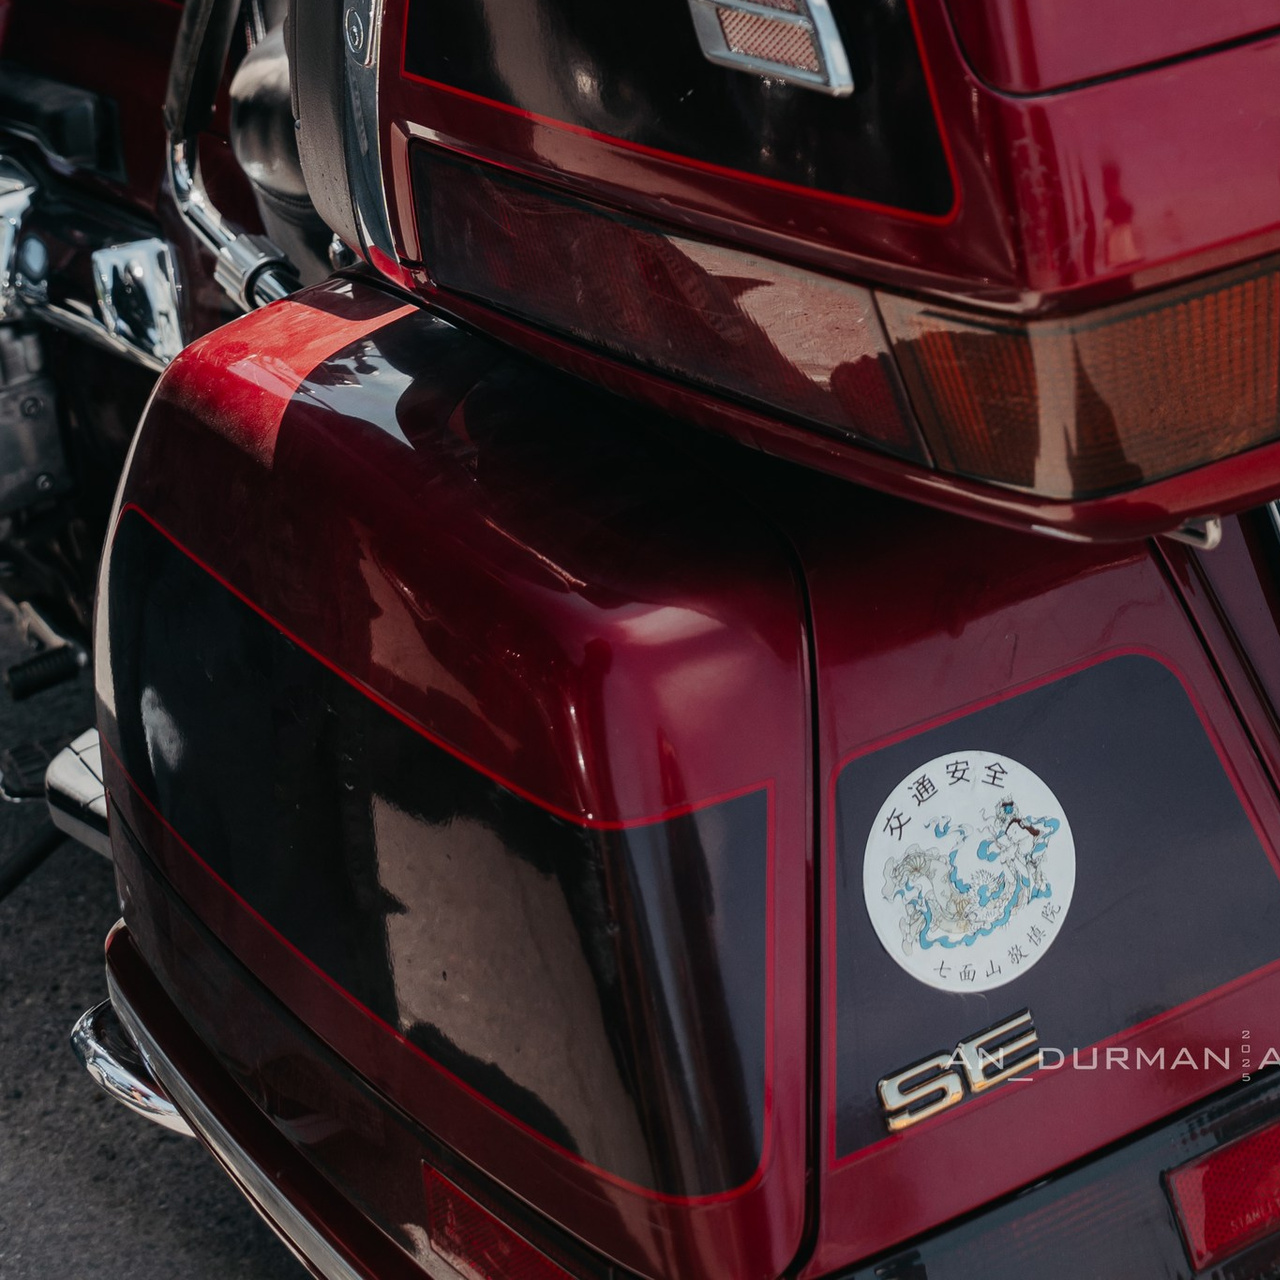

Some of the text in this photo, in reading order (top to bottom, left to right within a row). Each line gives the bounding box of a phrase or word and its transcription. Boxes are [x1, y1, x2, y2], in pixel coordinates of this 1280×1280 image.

[883, 760, 1008, 842] 交通安全
[876, 1007, 1044, 1133] SE
